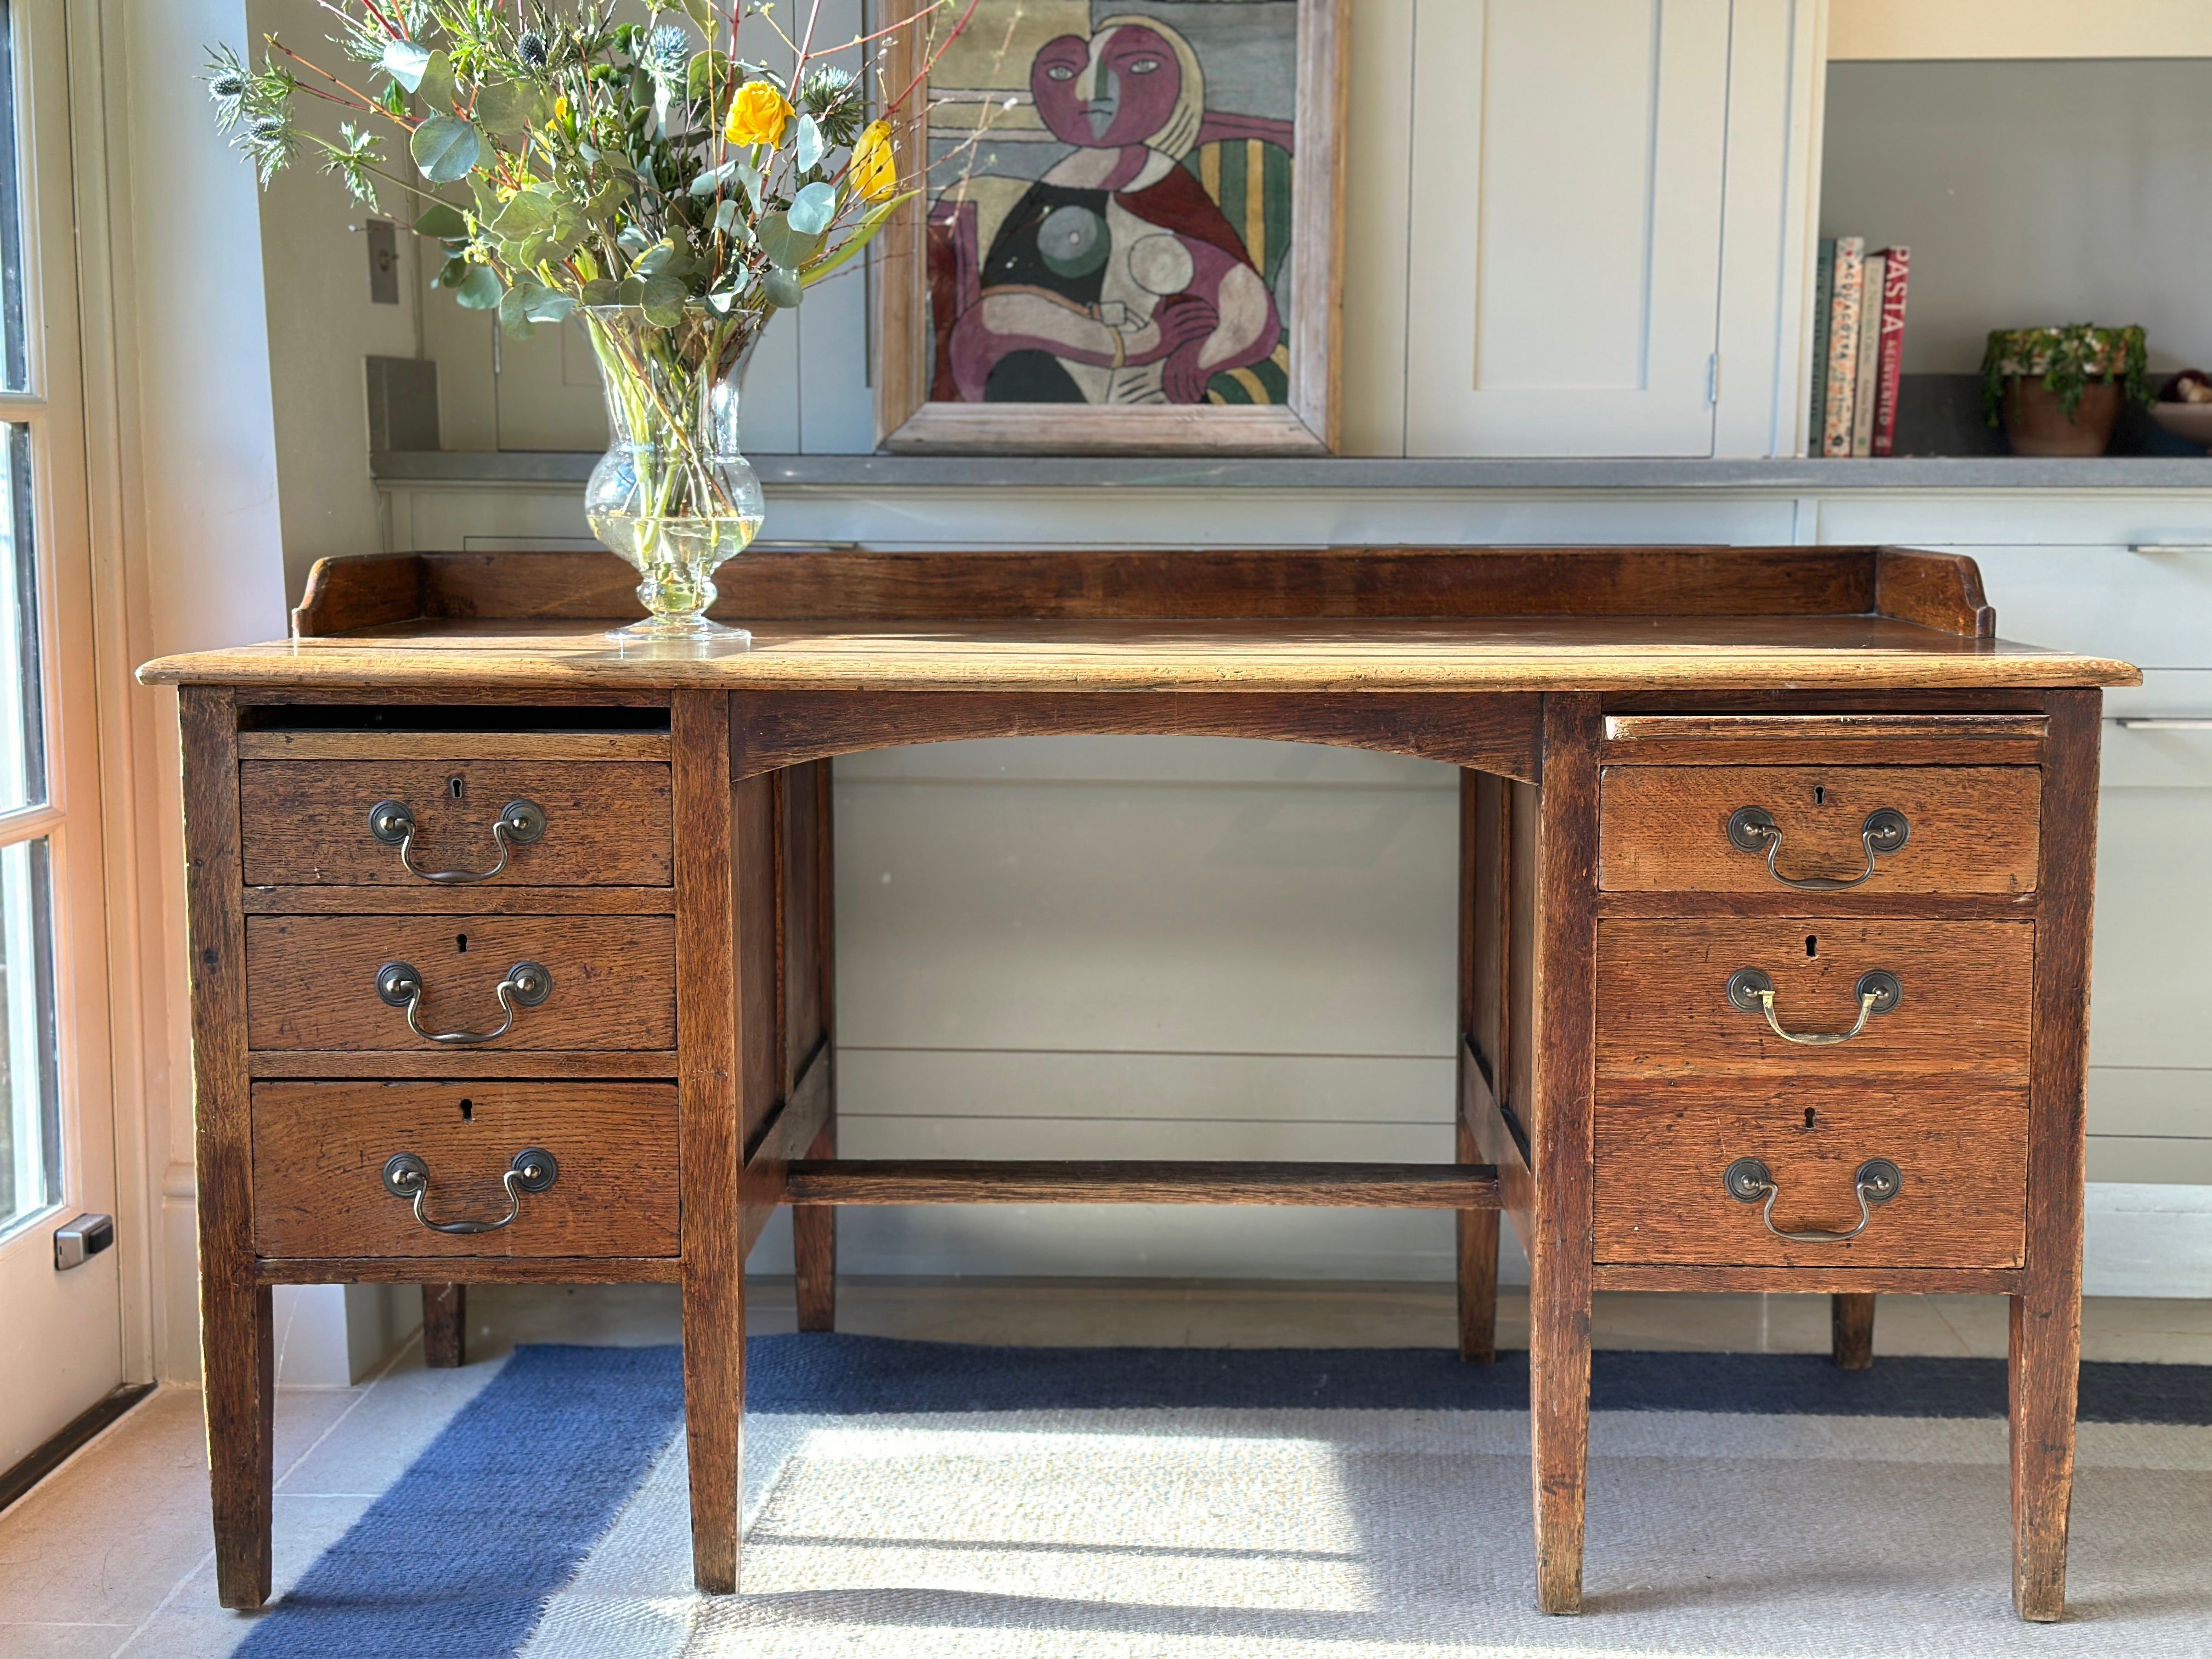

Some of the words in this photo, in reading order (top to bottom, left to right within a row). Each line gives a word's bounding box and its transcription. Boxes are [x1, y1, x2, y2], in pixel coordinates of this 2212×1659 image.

[1837, 261, 1854, 360] ACQUACOTTA
[1881, 245, 1911, 334] PASTA
[1878, 338, 1897, 426] REINVENTED
